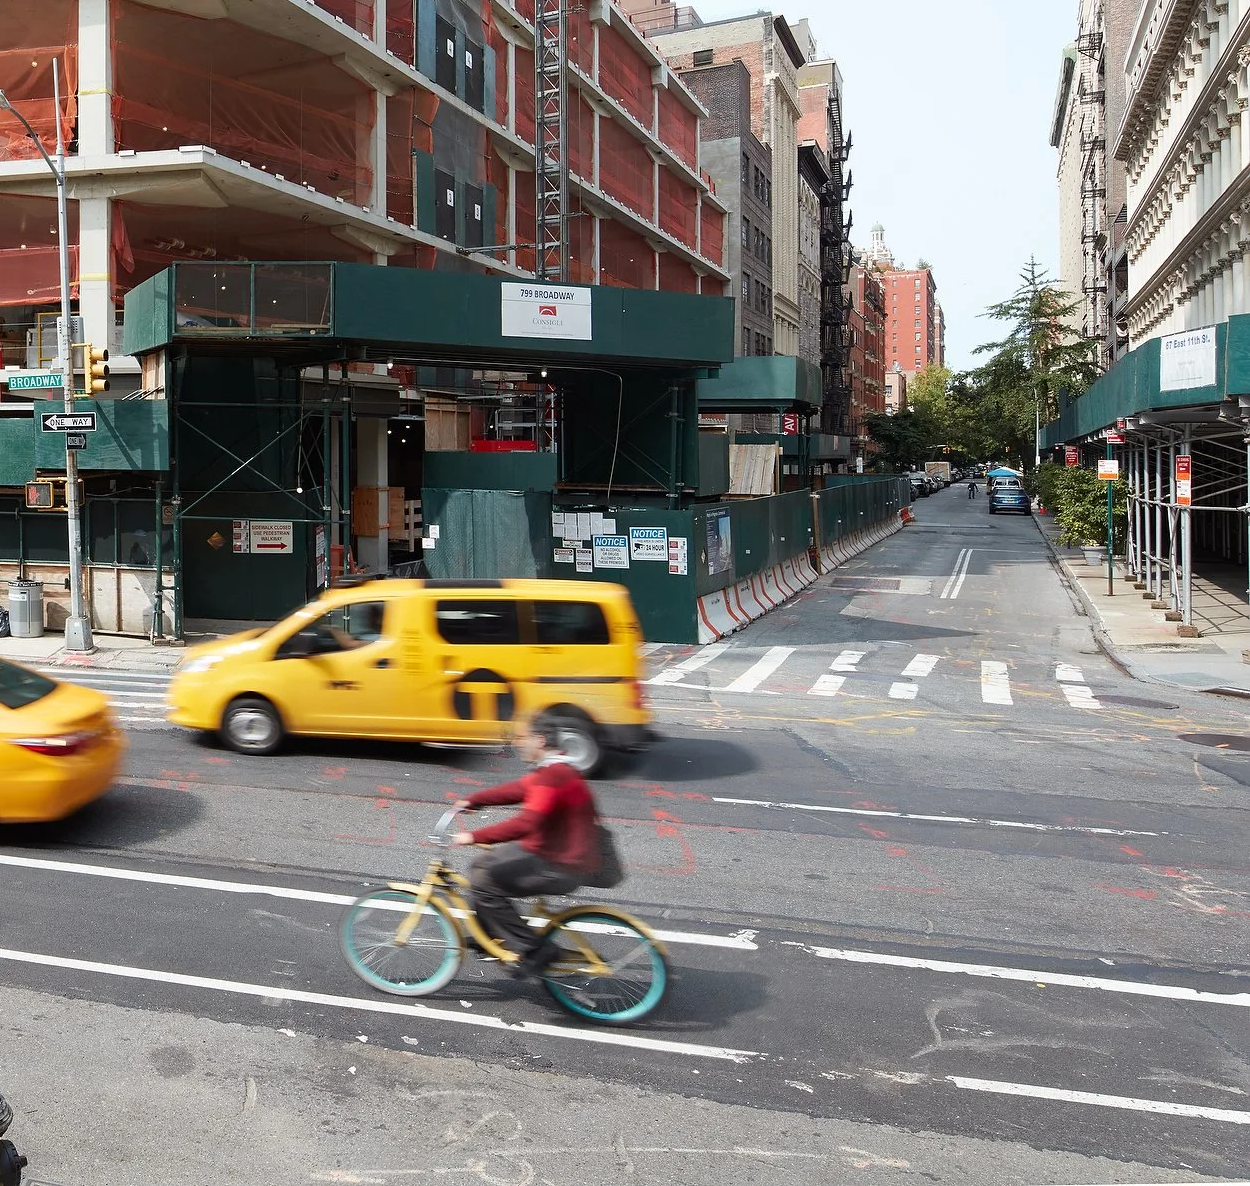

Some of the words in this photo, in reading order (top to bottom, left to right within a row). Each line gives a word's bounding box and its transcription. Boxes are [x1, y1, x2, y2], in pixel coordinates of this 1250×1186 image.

[520, 289, 533, 298] 799
[534, 290, 575, 300] BROADWAY
[532, 317, 563, 326] CONSIGLI
[1173, 339, 1186, 349] East
[1187, 335, 1201, 346] 11th
[10, 375, 61, 388] BROADWAY
[49, 418, 65, 426] ONE
[71, 418, 89, 426] WAY
[632, 529, 664, 538] NOTICE
[595, 537, 625, 546] NOTICE
